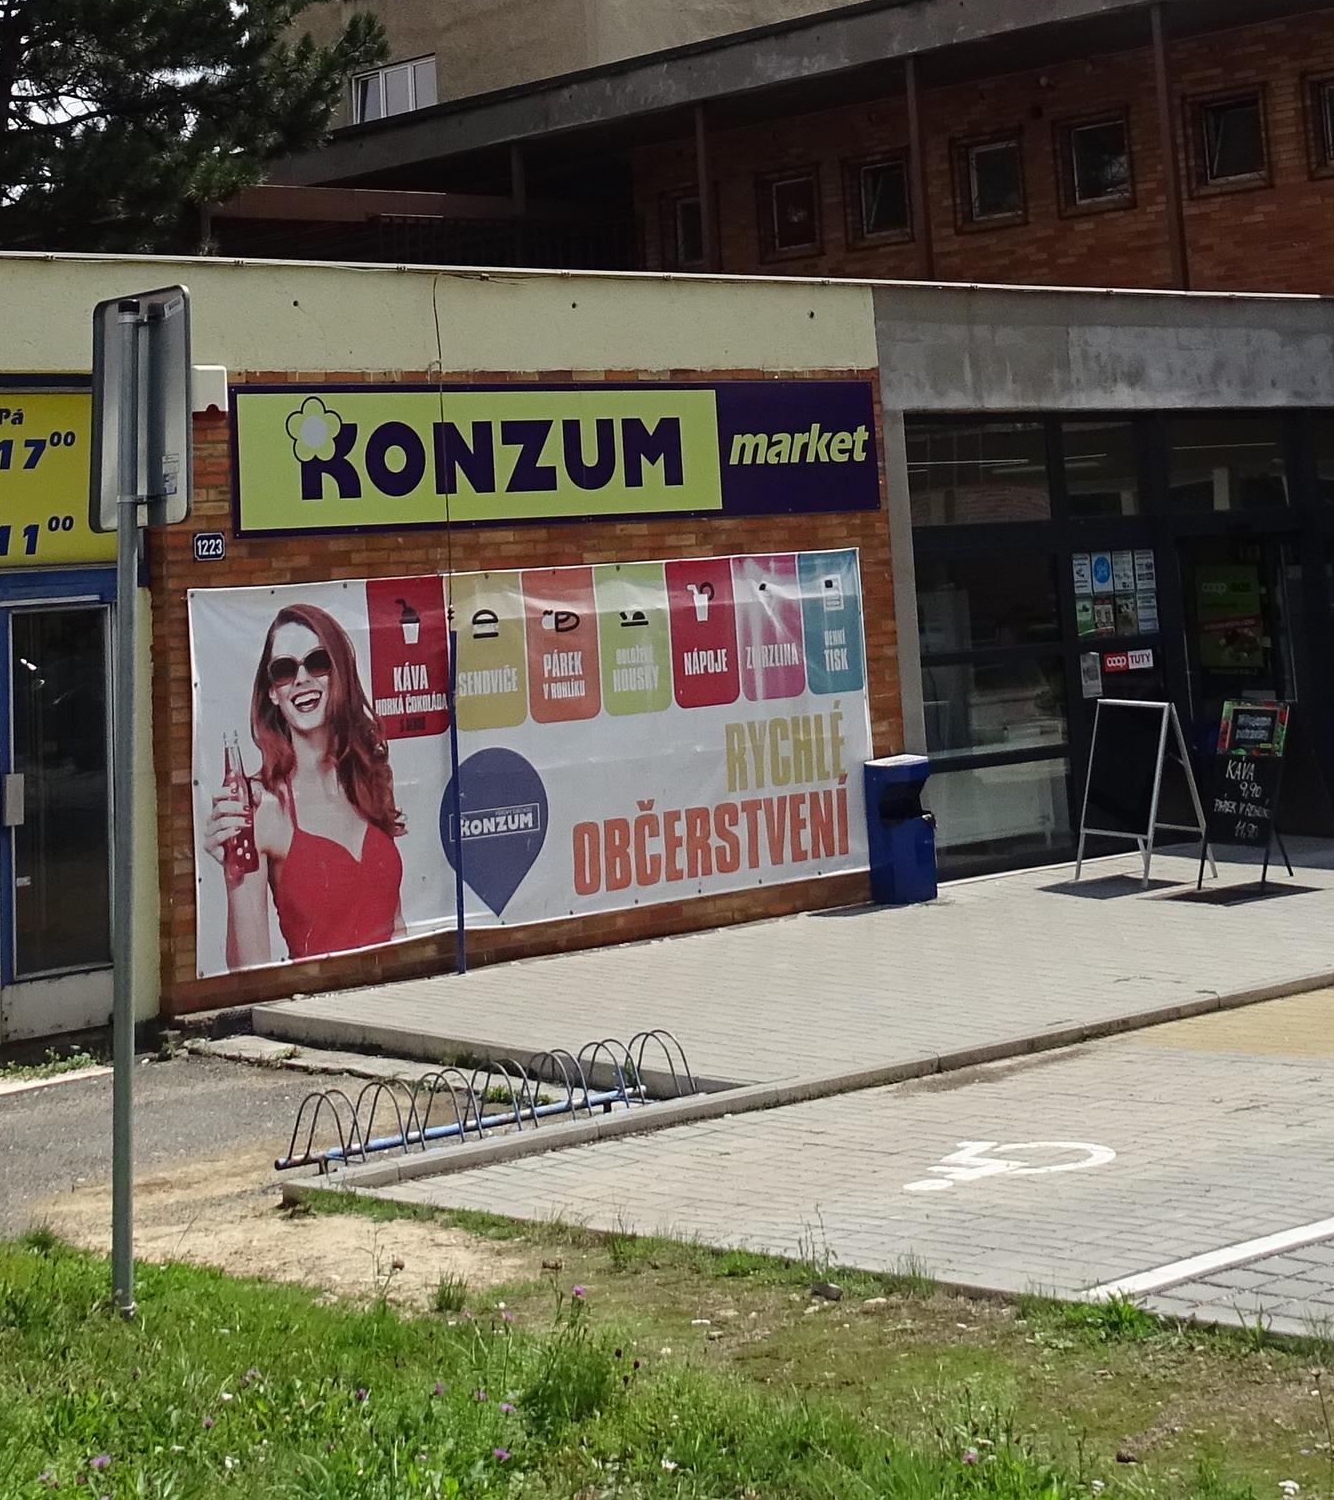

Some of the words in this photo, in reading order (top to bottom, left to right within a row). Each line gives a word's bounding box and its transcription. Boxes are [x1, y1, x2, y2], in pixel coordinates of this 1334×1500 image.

[301, 416, 683, 500] KONZUM
[729, 424, 869, 465] market
[197, 539, 223, 556] 1223
[543, 649, 583, 678] PÁREK
[684, 647, 728, 676] NÁPOJE
[823, 648, 849, 672] TISK
[1130, 652, 1152, 665] TUTY
[393, 662, 429, 692] KÁVA
[543, 683, 549, 700] V
[551, 678, 586, 699] ROHLÍKU
[405, 691, 448, 715] ČOKOLÁDA
[725, 700, 846, 793] RYCHLÉ
[1226, 756, 1255, 781] KÁVA
[461, 813, 533, 837] KONZUM
[573, 772, 850, 896] OBČERSTVENÍ
